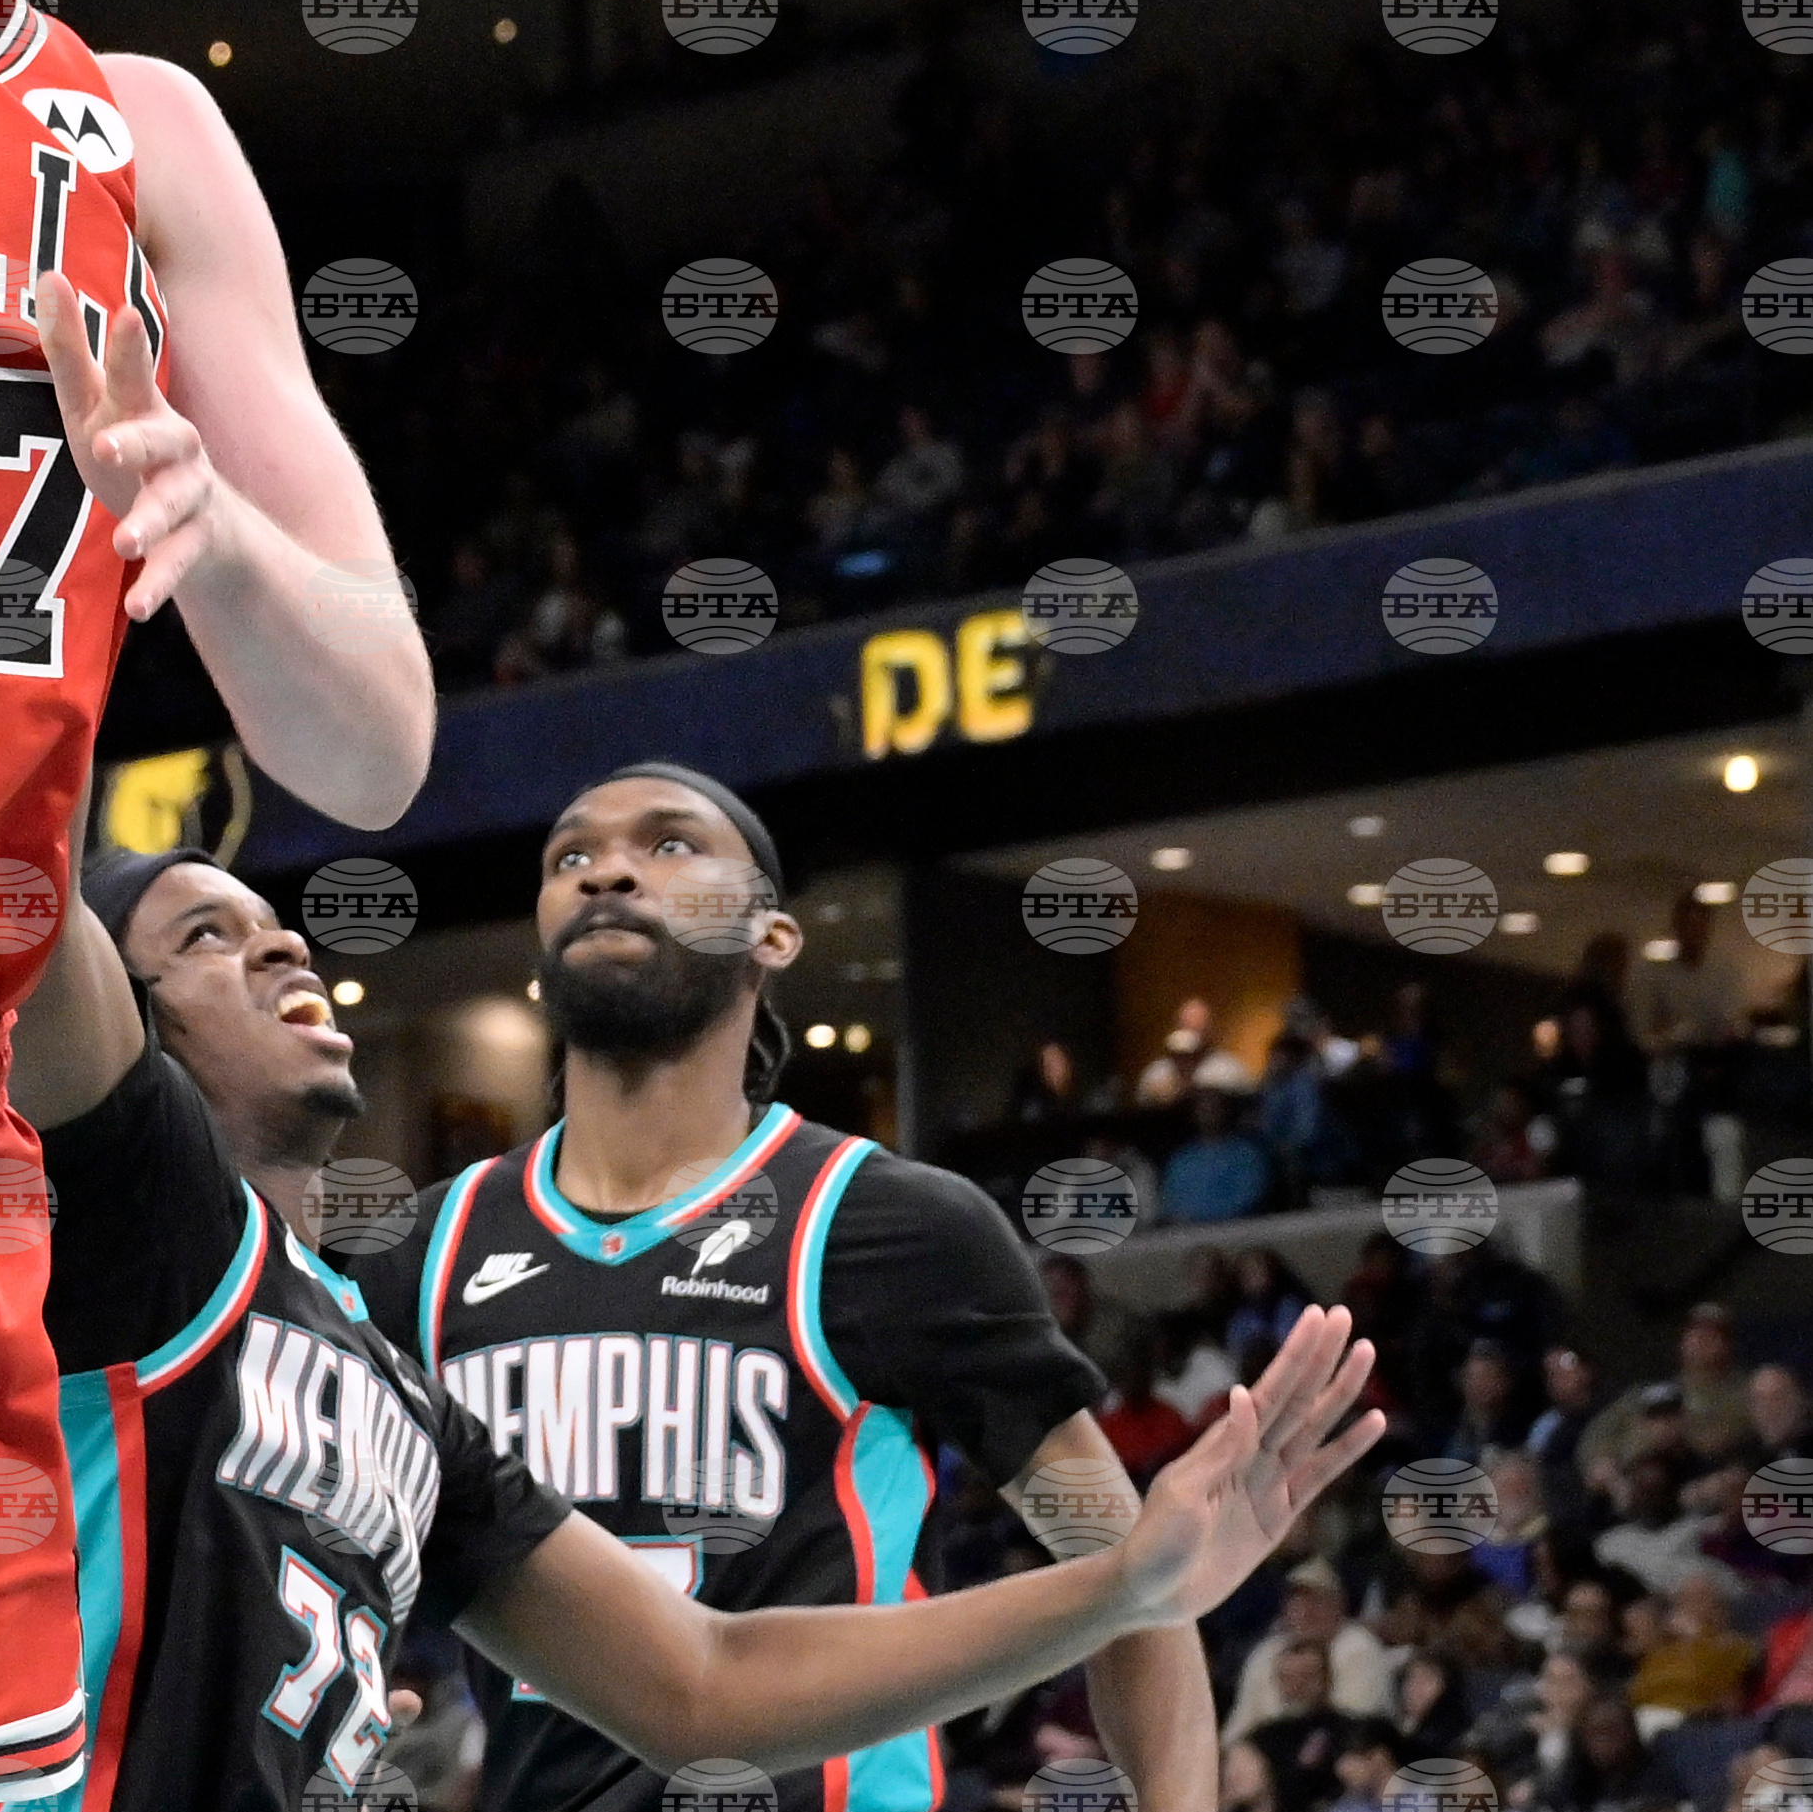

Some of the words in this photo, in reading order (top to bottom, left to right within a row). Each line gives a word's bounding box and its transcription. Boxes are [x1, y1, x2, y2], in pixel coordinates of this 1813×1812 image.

[861, 608, 1036, 760] DE
[475, 1252, 533, 1283] NIKE
[661, 1275, 770, 1305] Robinhood
[261, 1544, 390, 1798] 72
